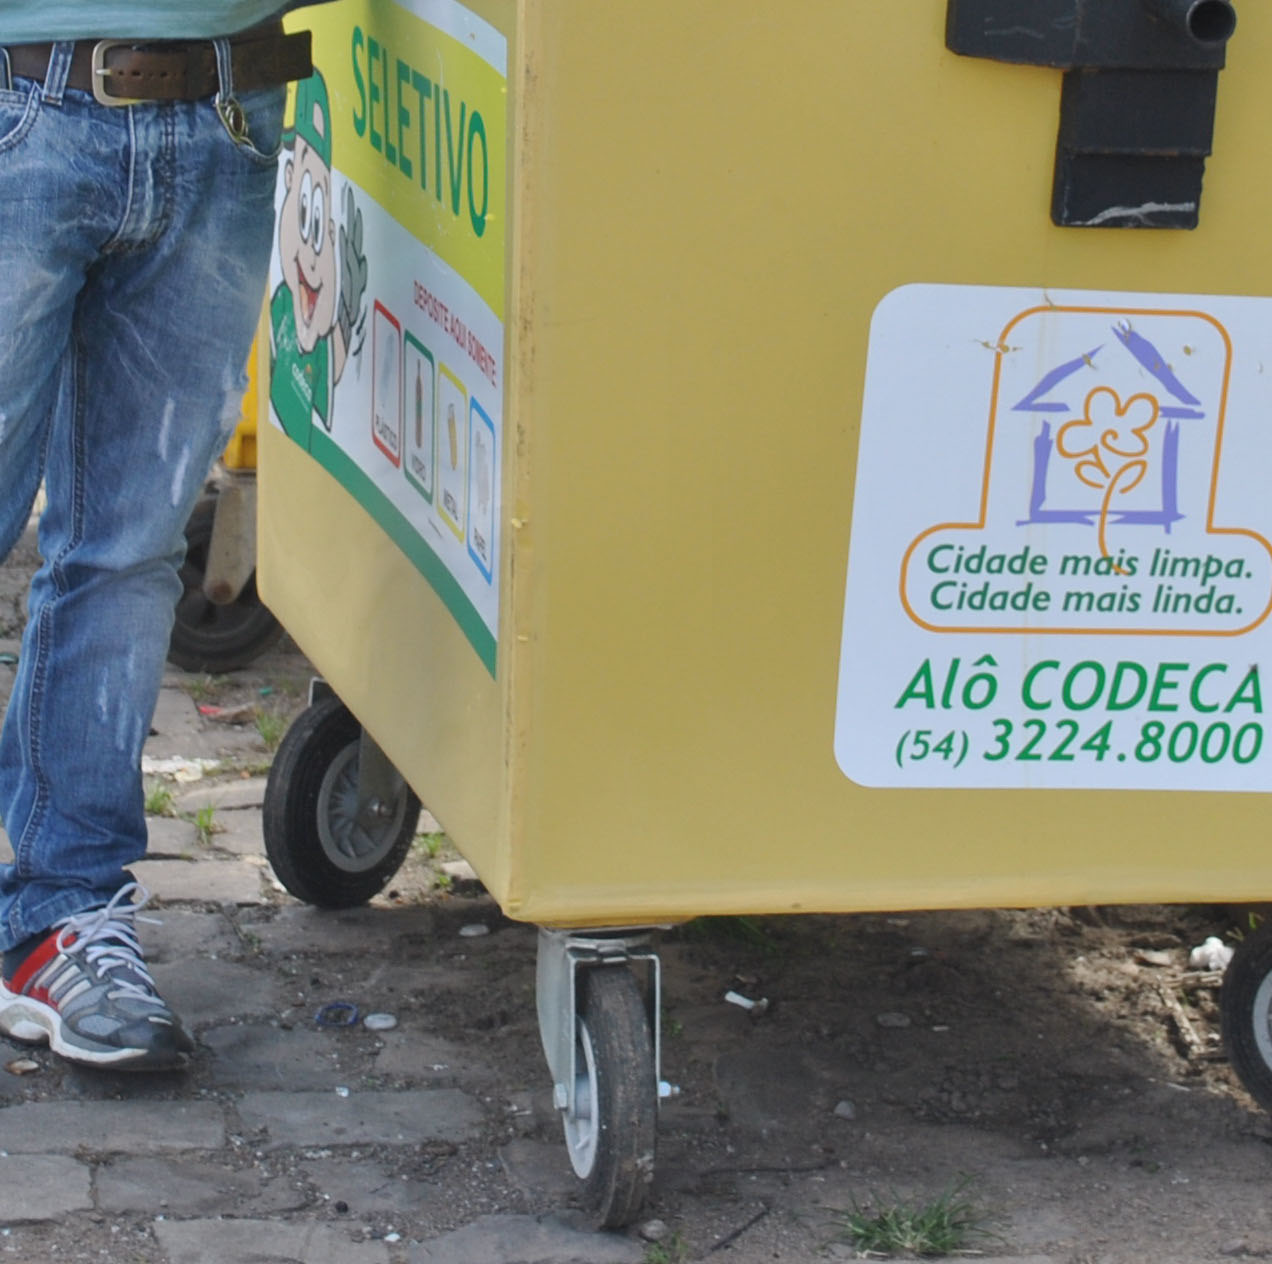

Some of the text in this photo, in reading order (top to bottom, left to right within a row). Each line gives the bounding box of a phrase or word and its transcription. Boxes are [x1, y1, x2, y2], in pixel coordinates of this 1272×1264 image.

[352, 25, 489, 238] SELETIVO
[414, 280, 496, 389] DEPOSITE AQUI SOMENTE
[443, 488, 458, 521] METAL
[927, 544, 1253, 587] Cidade mais limpa.
[929, 580, 1243, 615] Cidade mais linda.
[894, 653, 1264, 714] Alô CODECA
[895, 718, 1263, 769] (54) 3224.8000
